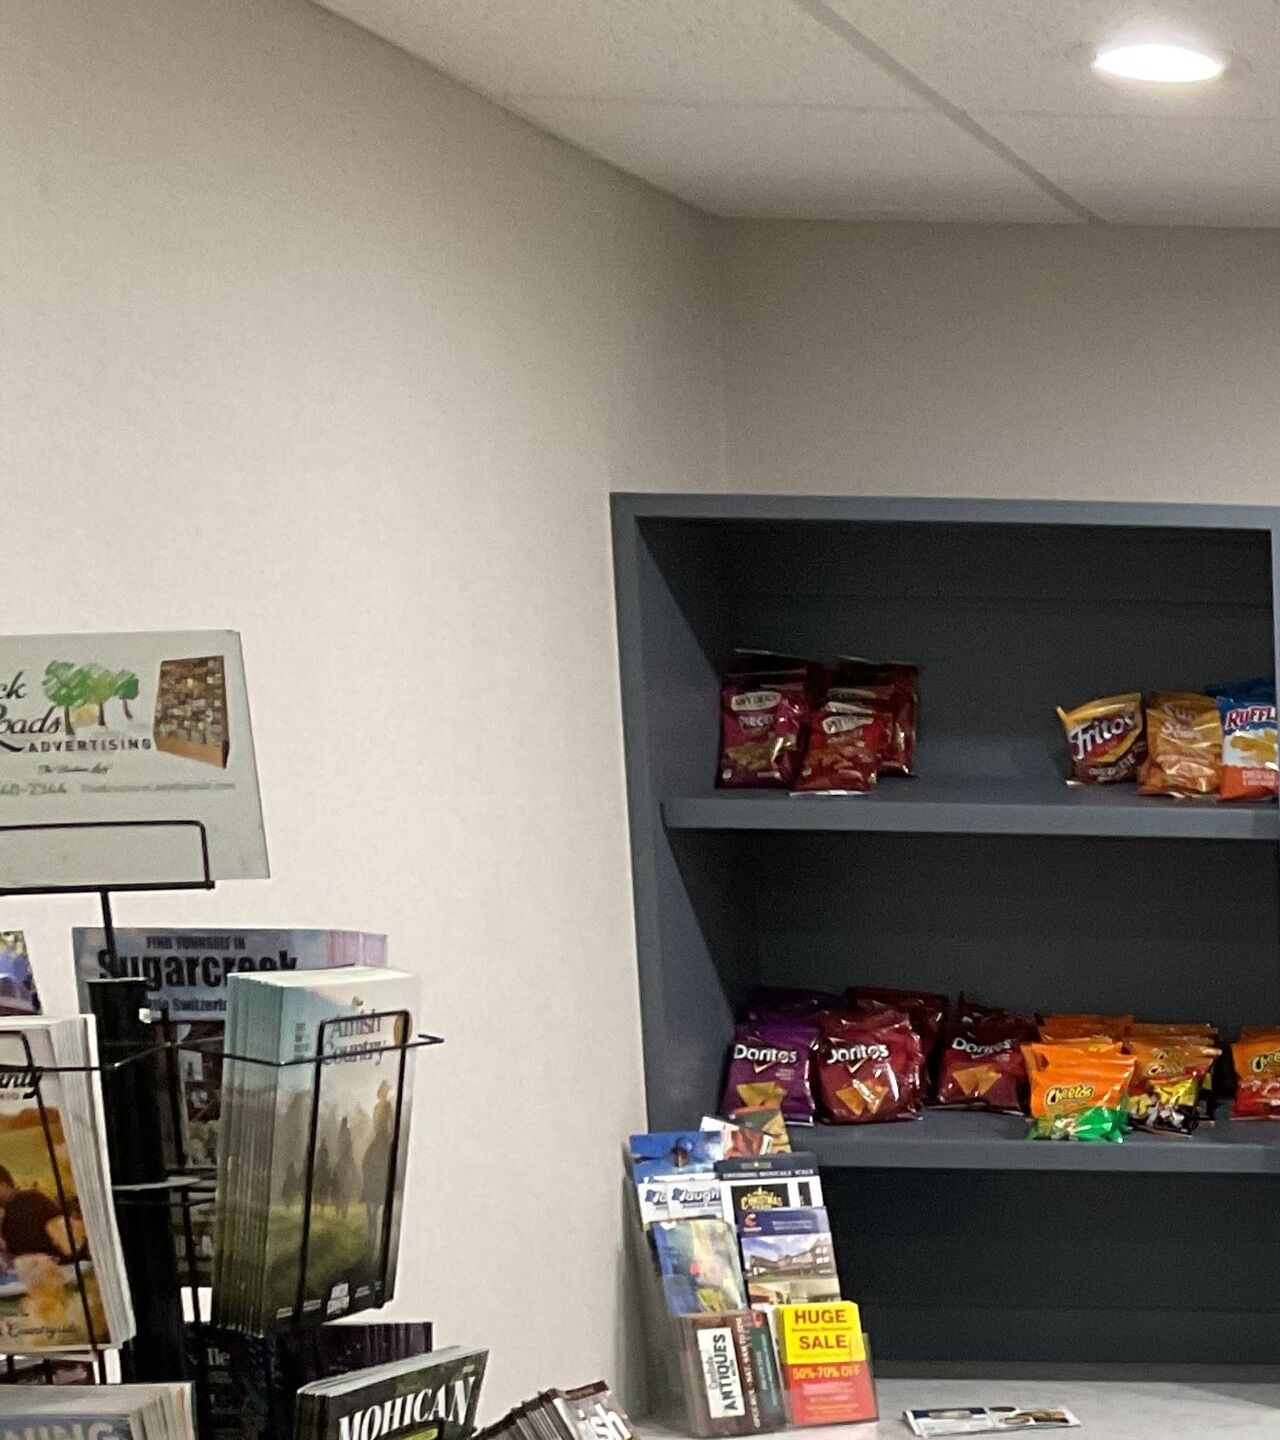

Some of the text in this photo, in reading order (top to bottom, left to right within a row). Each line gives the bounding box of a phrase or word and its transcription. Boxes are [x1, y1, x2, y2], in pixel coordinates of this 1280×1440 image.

[1225, 705, 1278, 730] RUFFL
[28, 738, 151, 753] ADVERTISING
[1068, 714, 1136, 761] Fritos
[733, 1043, 798, 1064] Doritos
[1044, 1084, 1096, 1105] Cheetos
[794, 1309, 847, 1325] HUGE
[799, 1334, 848, 1350] SALE
[712, 1333, 738, 1411] ANTIQUES
